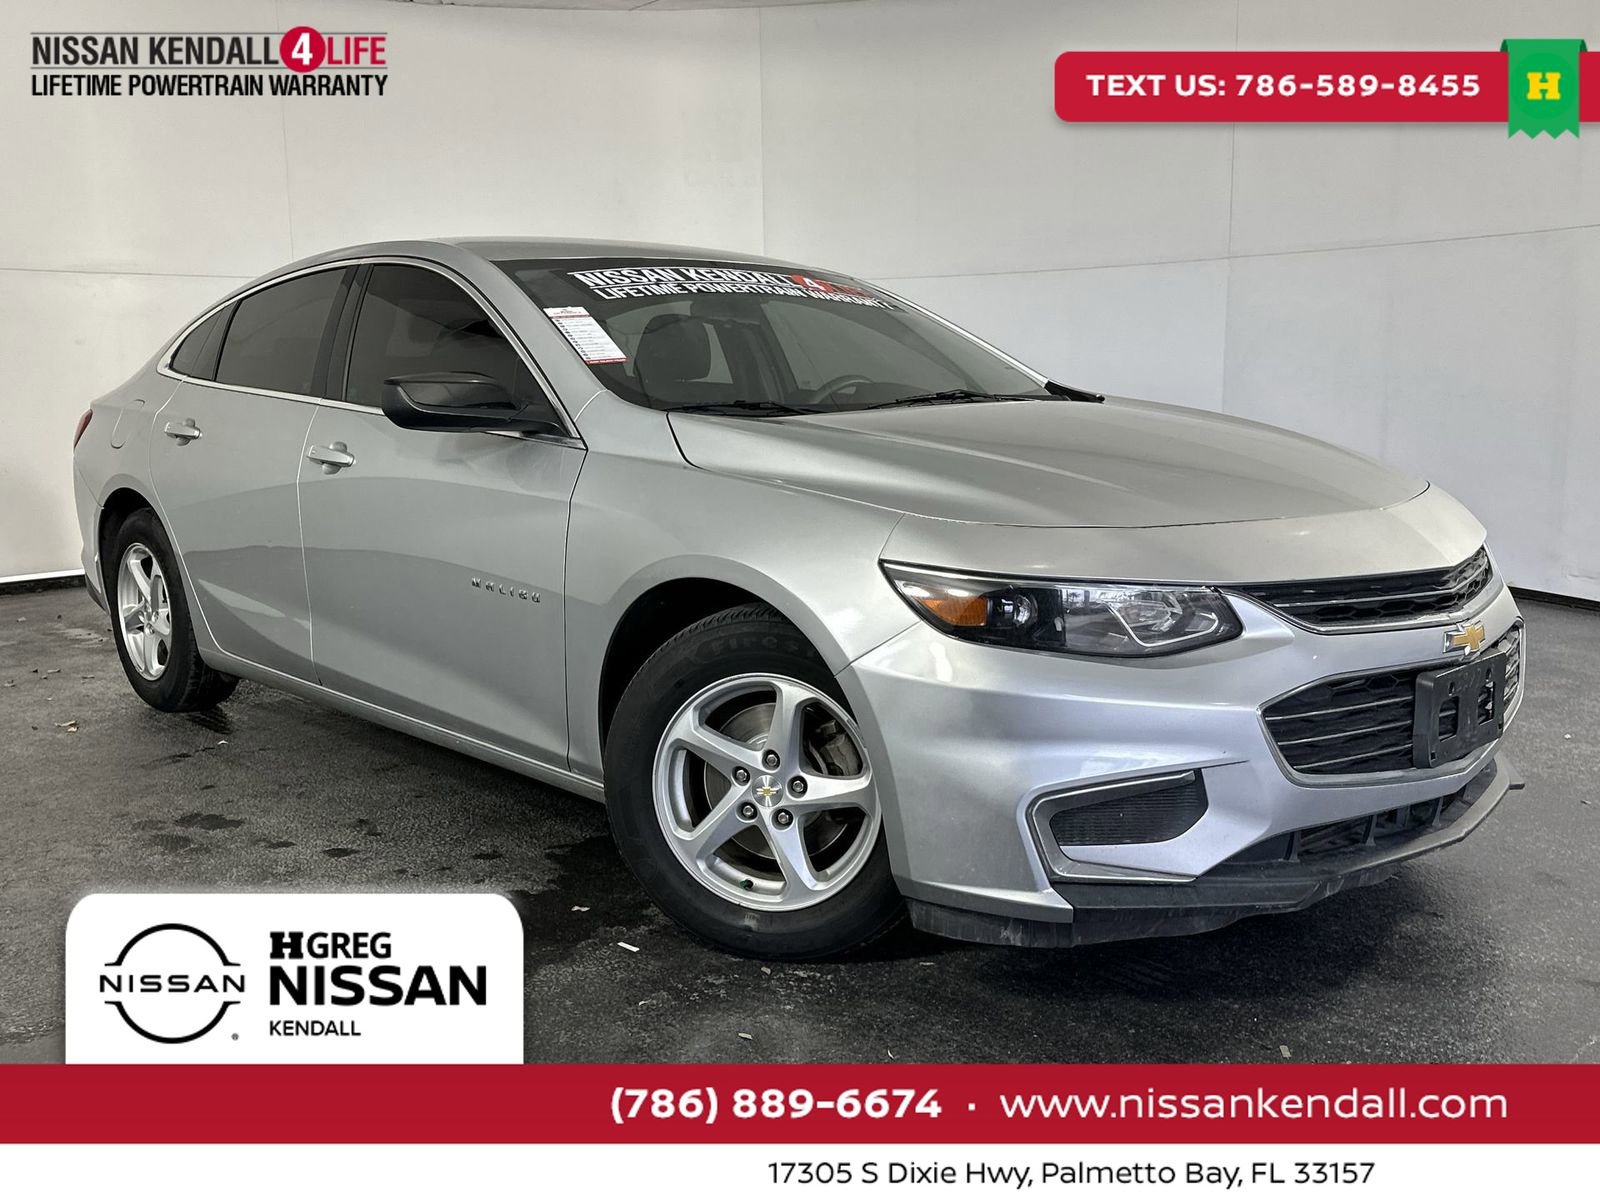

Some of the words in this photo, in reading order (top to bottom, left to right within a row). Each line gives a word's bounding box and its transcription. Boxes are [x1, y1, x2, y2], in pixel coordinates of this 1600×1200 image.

[573, 268, 686, 287] NISSAN
[679, 268, 796, 287] KENDALL
[593, 284, 688, 300] LIFETIME
